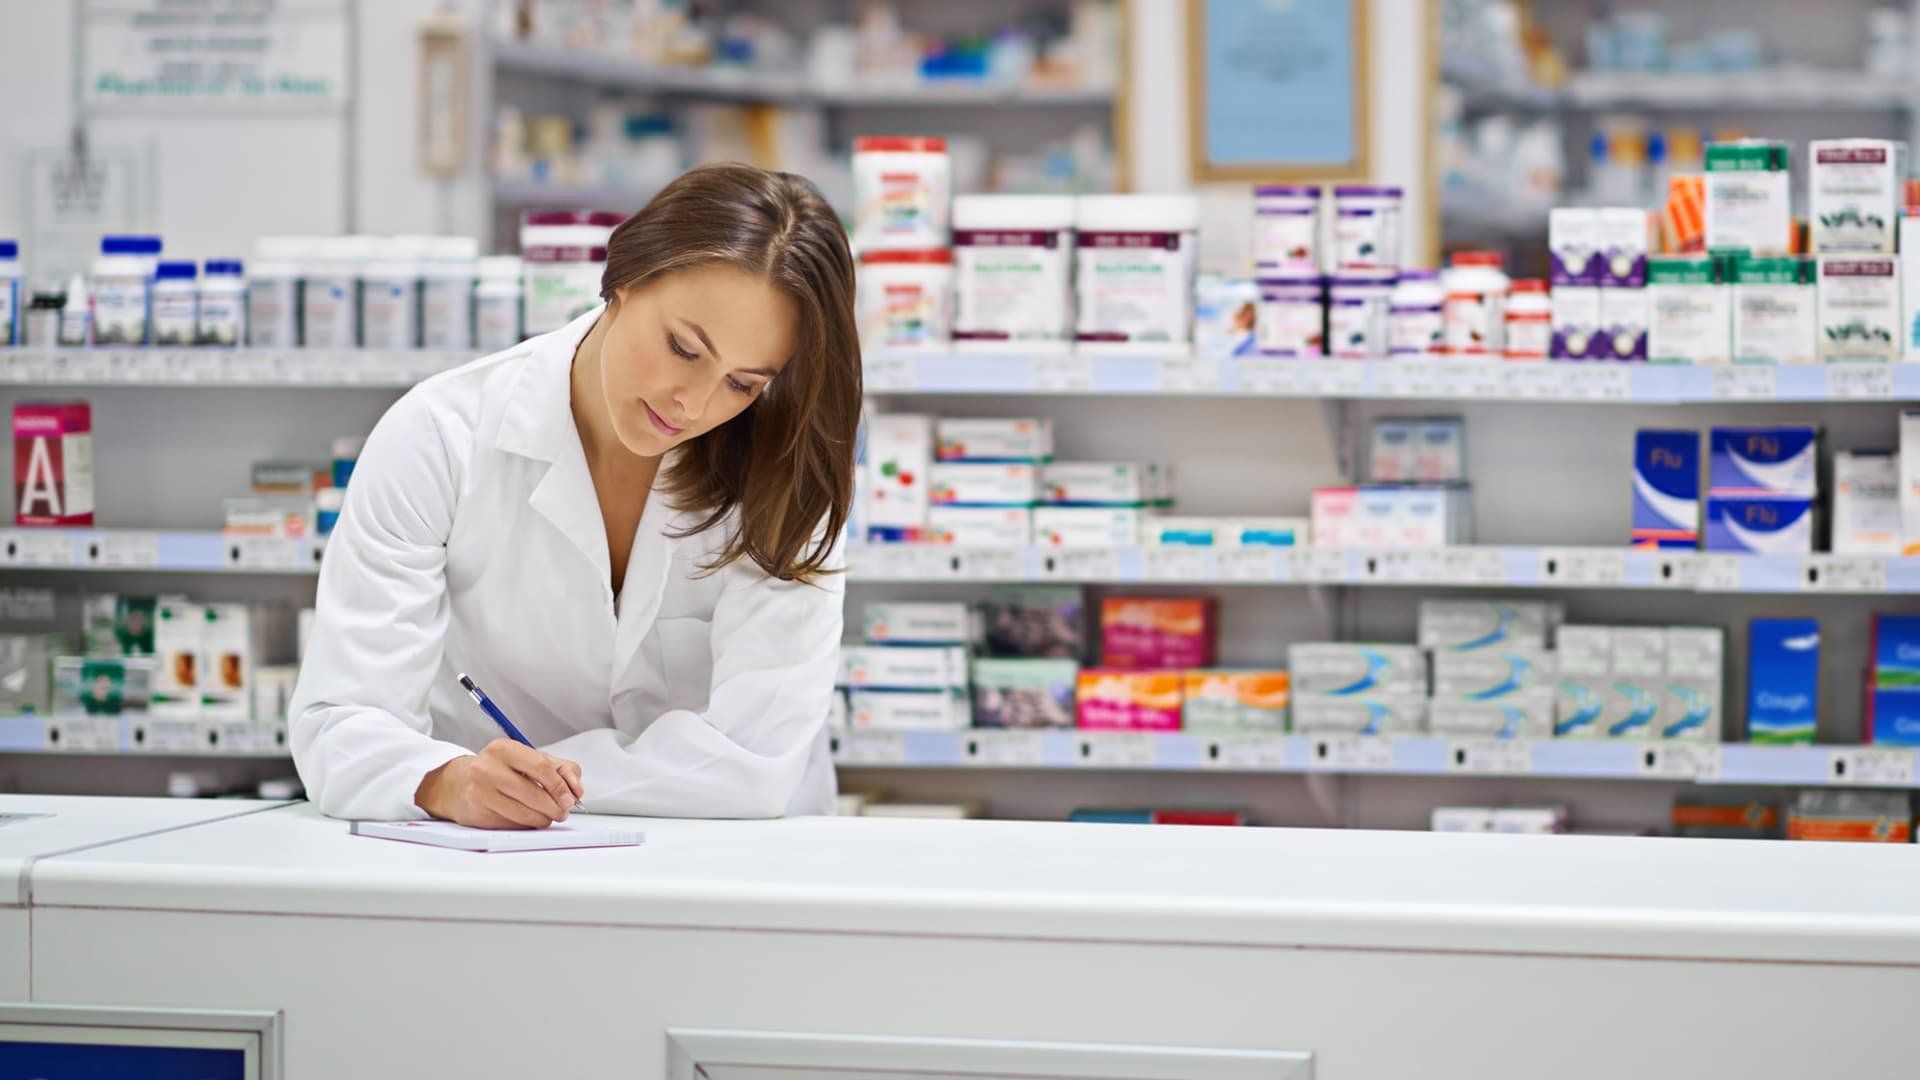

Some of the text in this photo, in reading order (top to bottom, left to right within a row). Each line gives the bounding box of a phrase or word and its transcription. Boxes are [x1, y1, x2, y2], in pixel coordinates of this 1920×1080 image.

[1747, 436, 1779, 456] Flu
[1651, 449, 1682, 469] Flu
[20, 436, 61, 515] A
[1746, 506, 1777, 525] Flu
[1756, 691, 1808, 712] Cough
